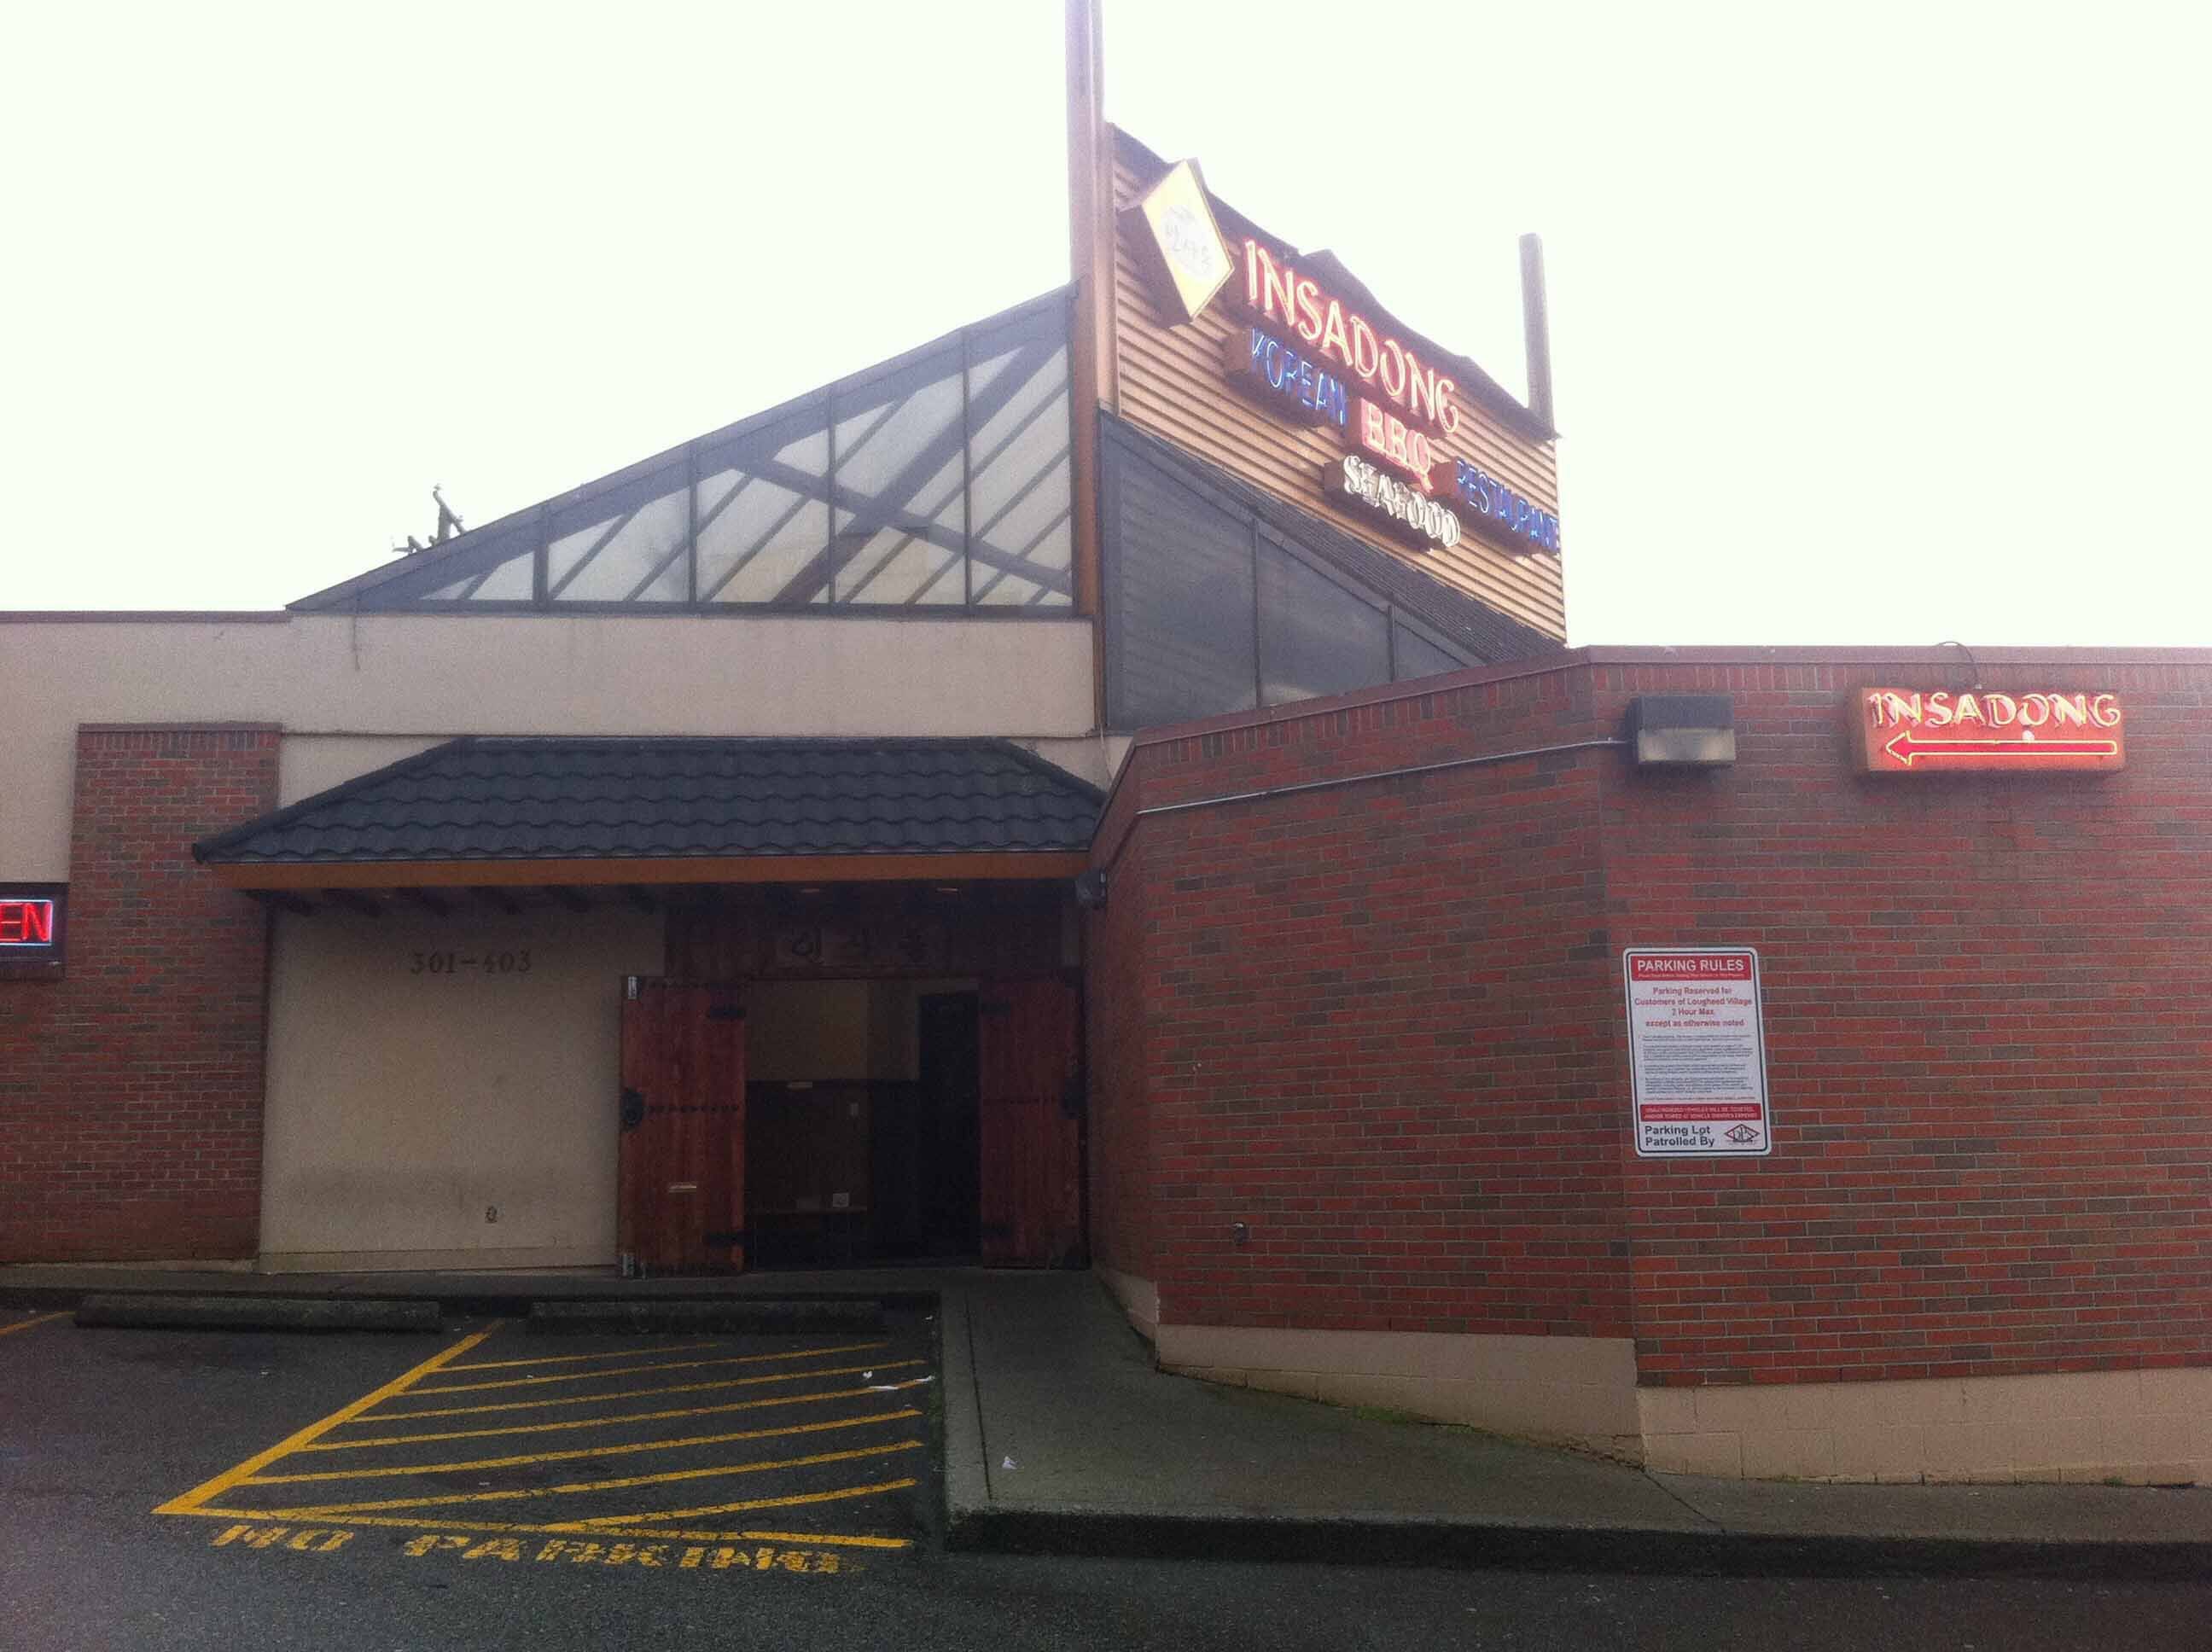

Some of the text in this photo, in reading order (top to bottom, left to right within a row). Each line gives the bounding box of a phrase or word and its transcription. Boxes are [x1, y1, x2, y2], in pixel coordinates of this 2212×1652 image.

[1245, 239, 1459, 433] INSADONG
[1361, 398, 1435, 492] BBQ
[1342, 454, 1461, 548] SEAFOOD
[1868, 692, 2122, 729] INSADONG
[410, 949, 533, 974] 301-403
[1637, 959, 1744, 972] PARKING RULES
[1653, 986, 1732, 998] Parking Reserved for
[1679, 998, 1686, 1006] of
[1687, 998, 1726, 1008] Lougheed
[1726, 997, 1753, 1008] Village
[1644, 1125, 1689, 1137] Parking
[1691, 1125, 1711, 1135] Lot
[1644, 1136, 1716, 1148] Patrolled By
[208, 1524, 843, 1573] NO PARKING
